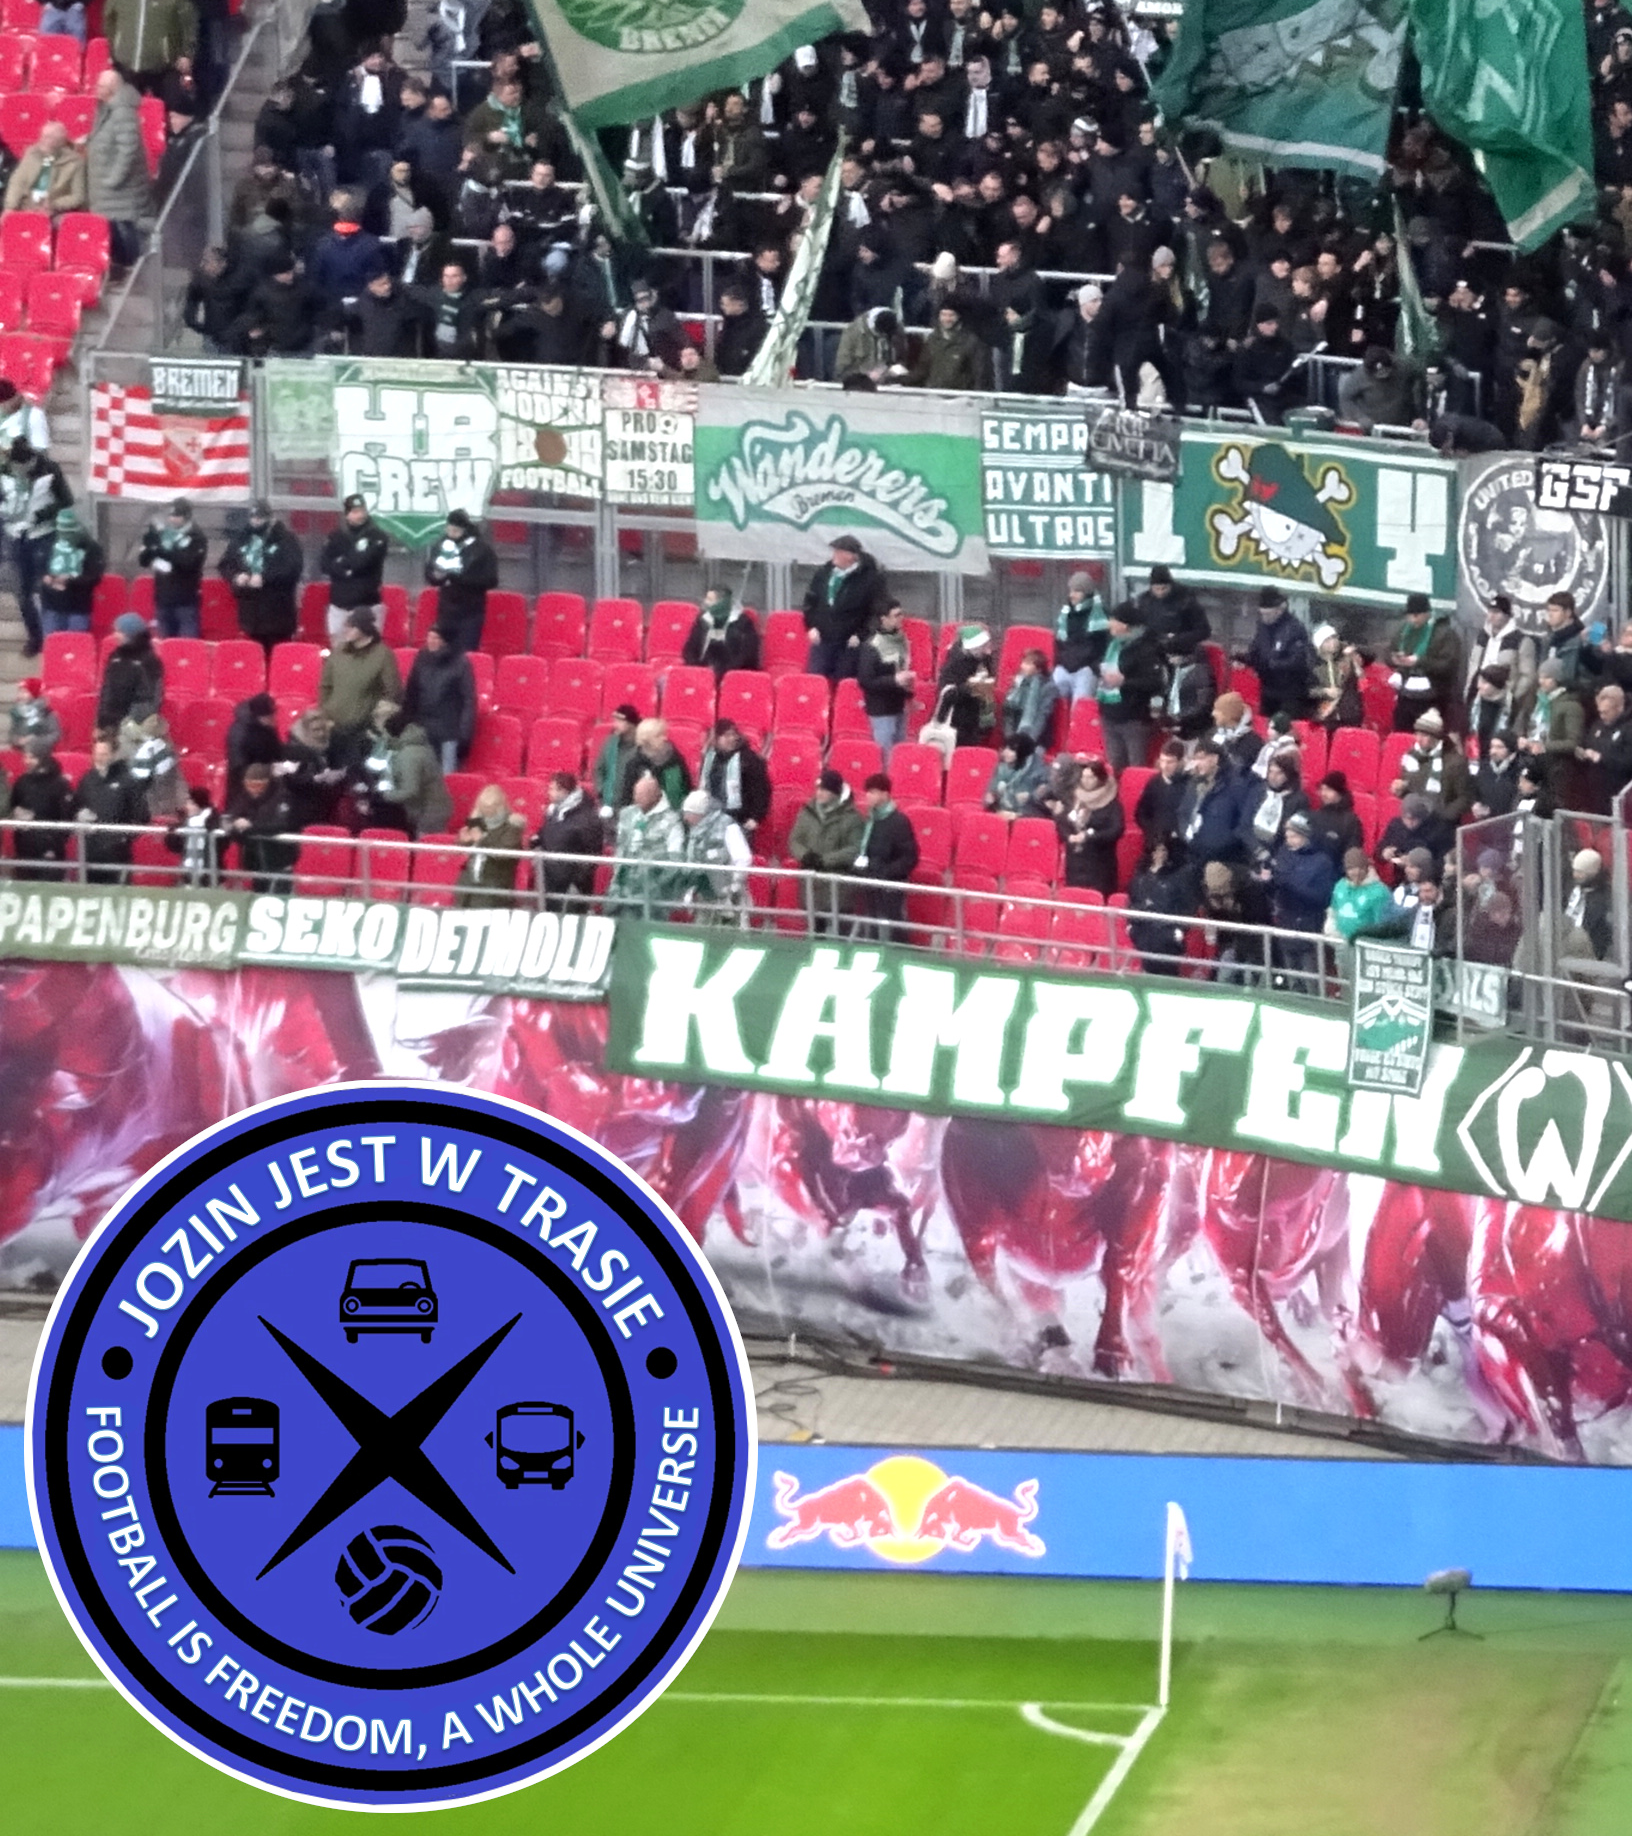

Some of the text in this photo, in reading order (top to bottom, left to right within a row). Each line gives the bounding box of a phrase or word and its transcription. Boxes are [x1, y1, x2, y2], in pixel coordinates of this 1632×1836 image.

[152, 367, 239, 398] BREMEN
[497, 389, 602, 426] MODERN
[621, 412, 657, 434] PRO
[607, 439, 693, 464] SAMSTAG
[984, 418, 1087, 452] SEMPR
[343, 452, 493, 516] CREW
[501, 467, 602, 498] FOOTBALL
[627, 469, 678, 491] 15:30
[708, 414, 952, 530] Wanderers
[984, 468, 1112, 505] AVANTI
[1539, 463, 1632, 512] GSF
[987, 515, 1114, 548] ULTRAS
[0, 893, 238, 955] PAPENBURG
[246, 897, 618, 984] SEKO DETMOLD
[634, 935, 1465, 1174] KÄMPFEN
